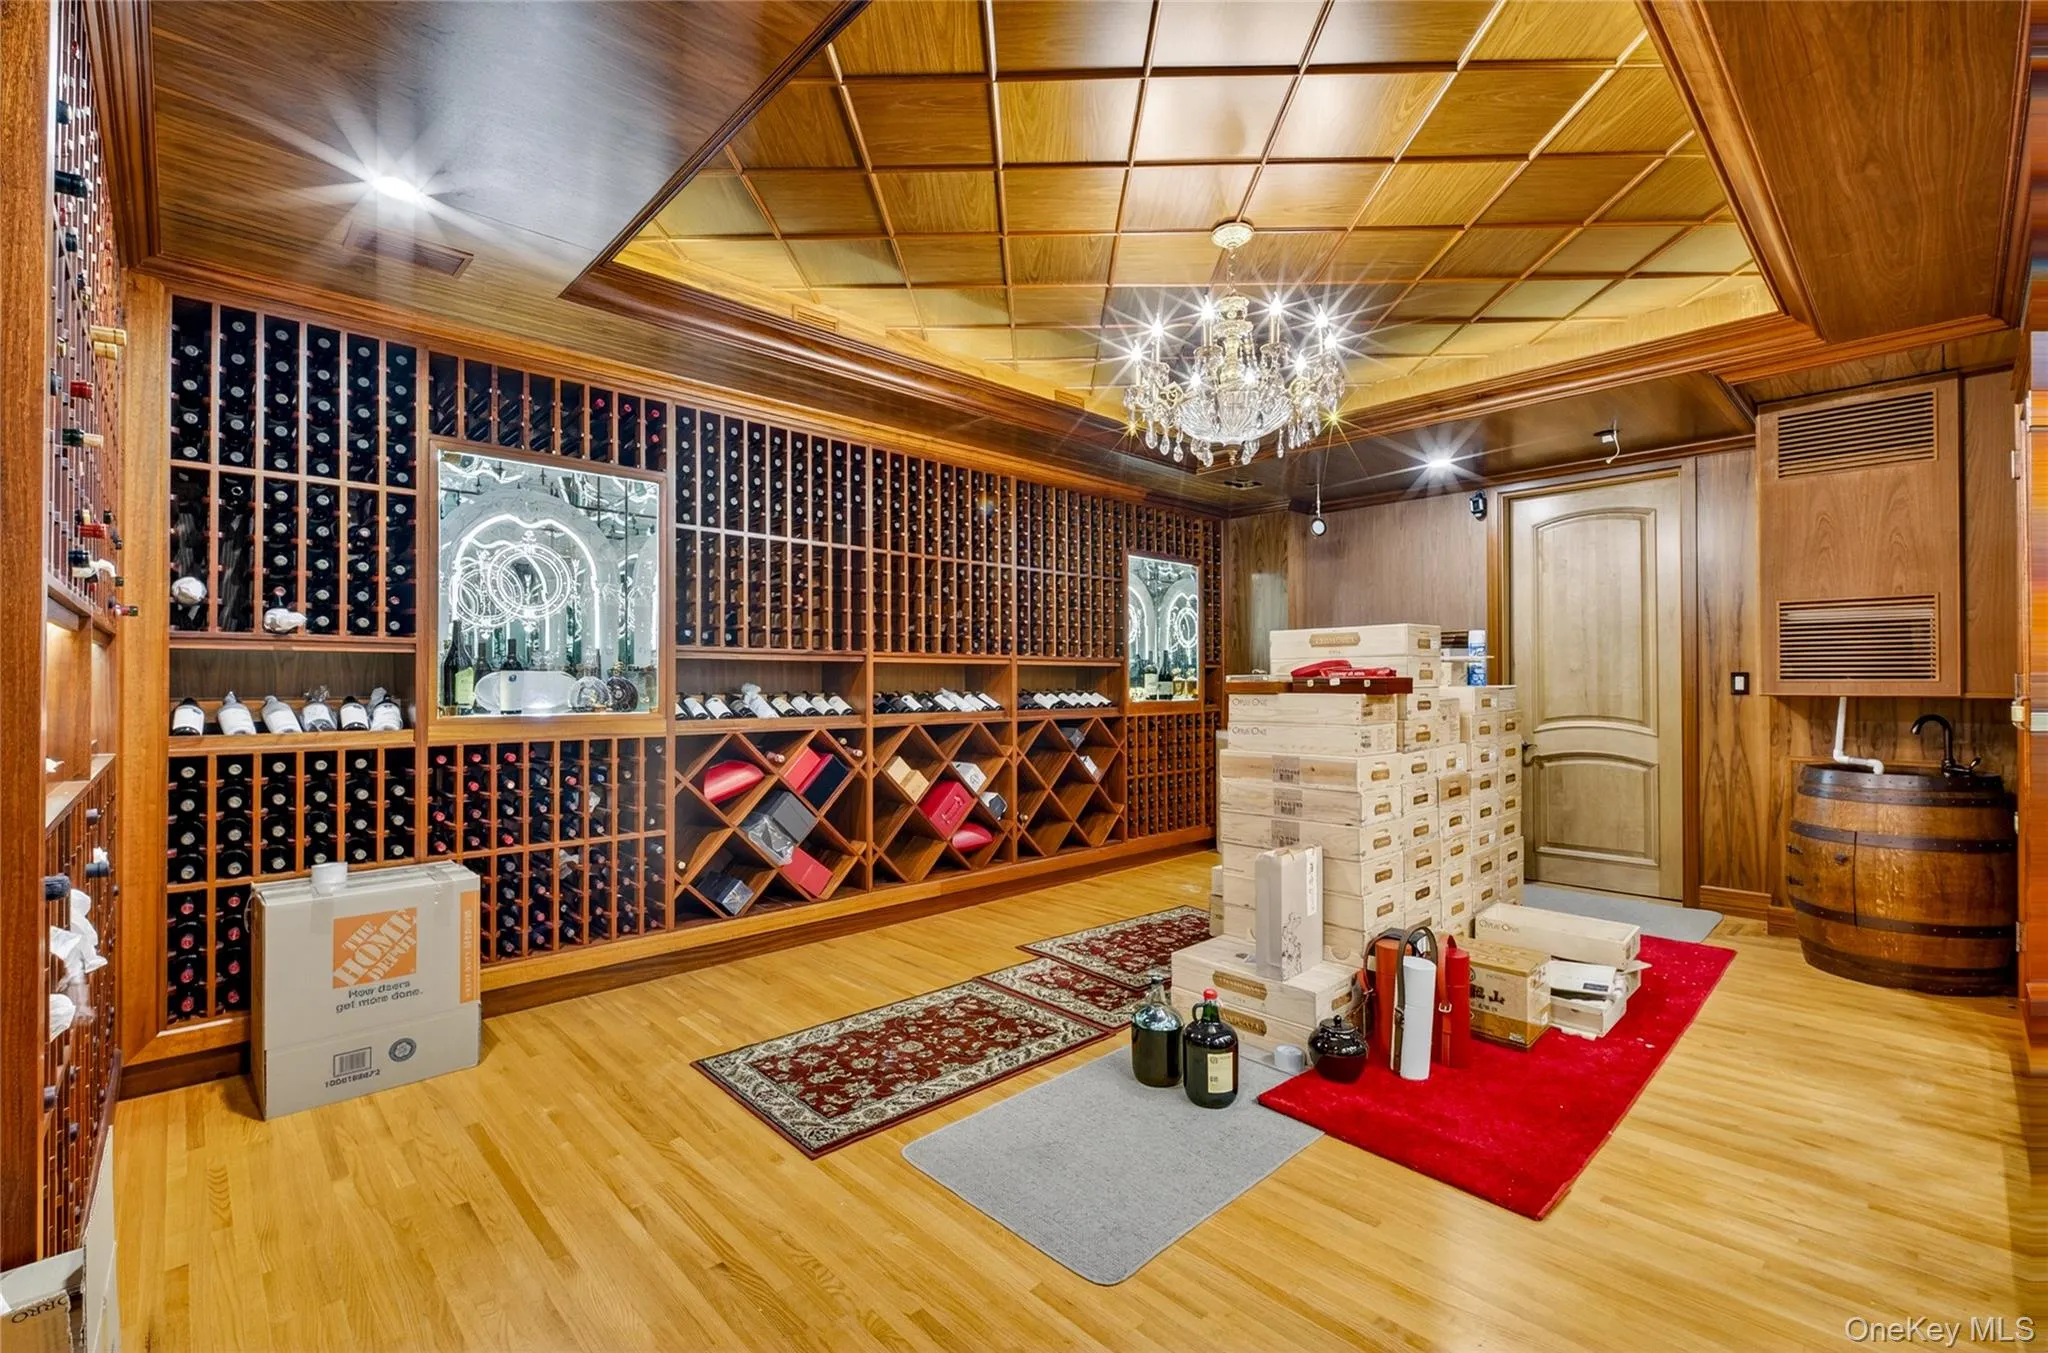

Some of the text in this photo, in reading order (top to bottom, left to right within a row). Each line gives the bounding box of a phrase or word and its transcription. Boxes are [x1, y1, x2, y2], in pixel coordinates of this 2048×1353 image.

[333, 909, 417, 986] HOME
[342, 920, 377, 952] THE
[366, 934, 417, 980] DEPOT
[335, 1000, 356, 1014] get
[358, 994, 389, 1007] more
[348, 980, 411, 999] How doers
